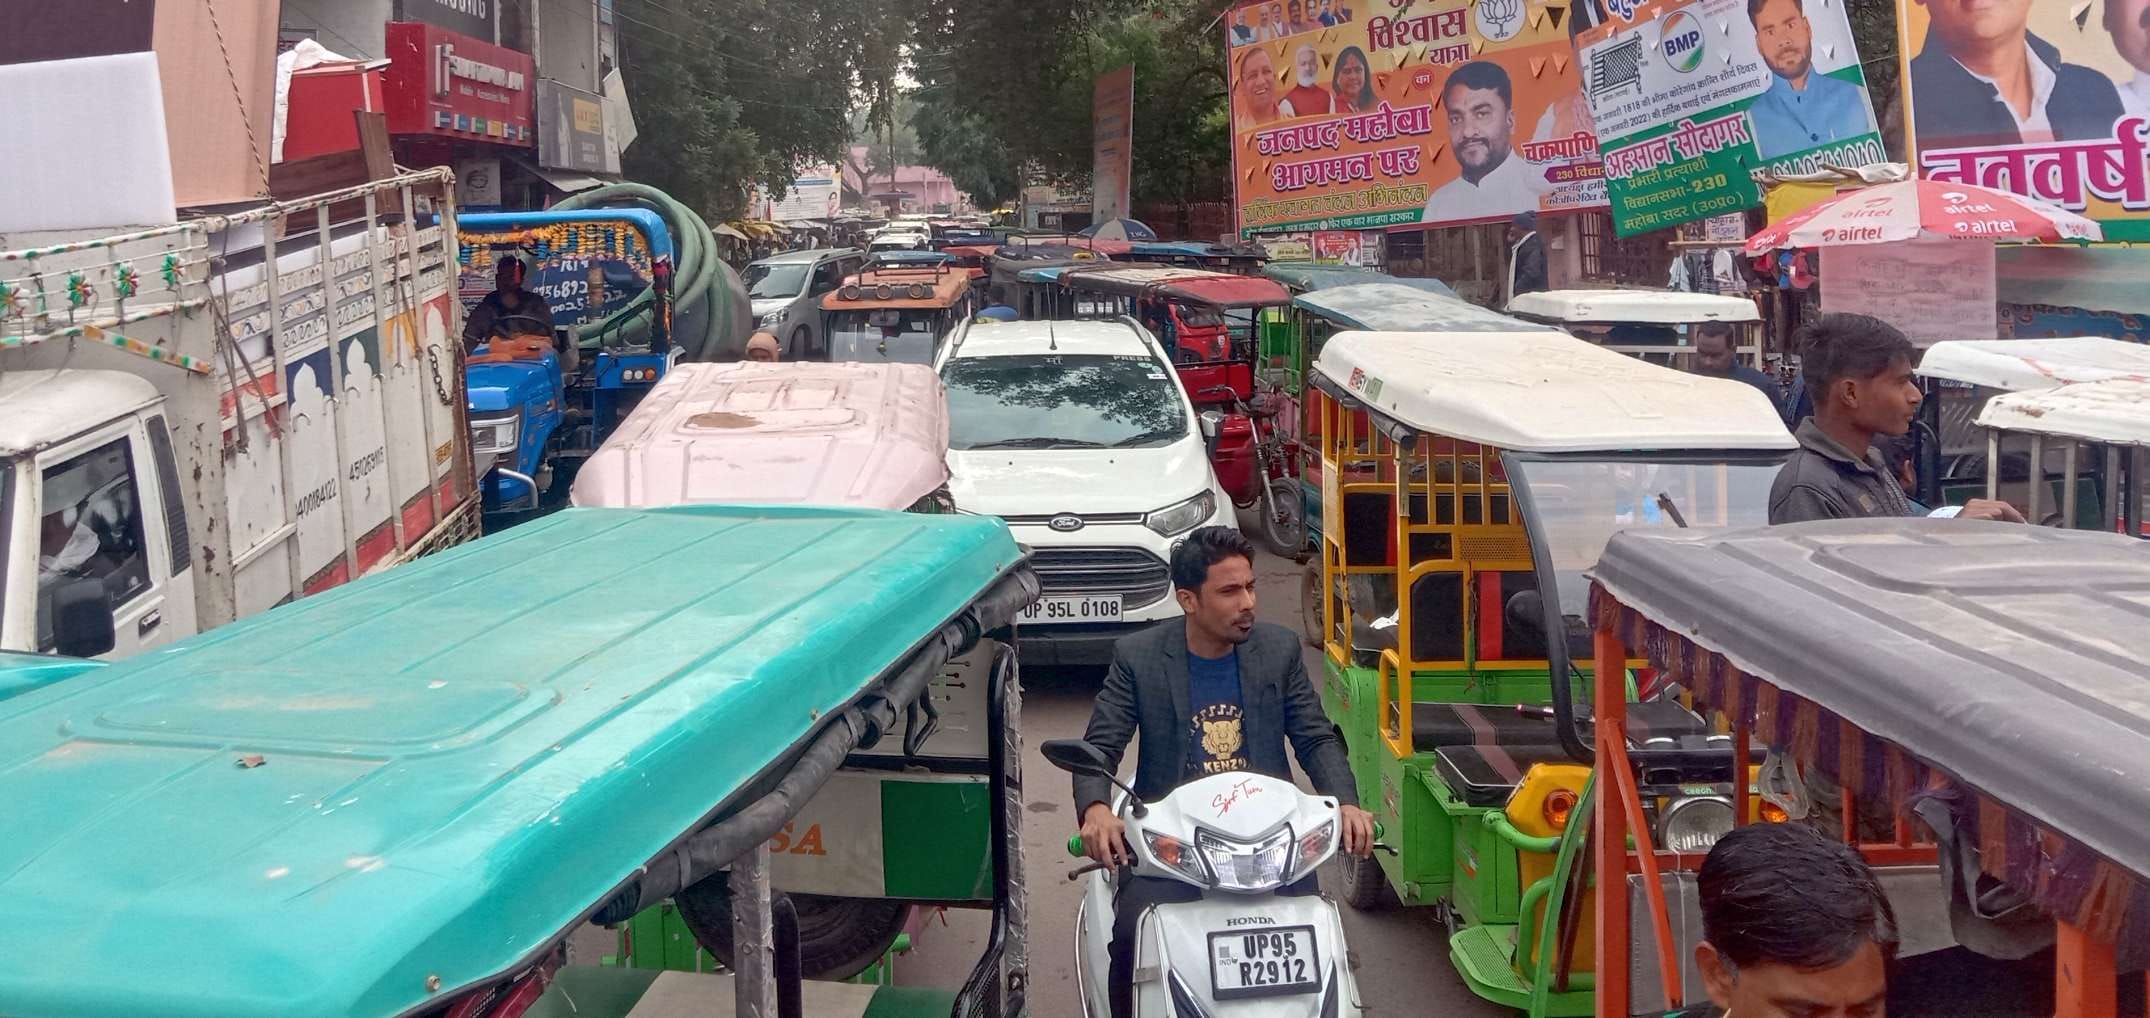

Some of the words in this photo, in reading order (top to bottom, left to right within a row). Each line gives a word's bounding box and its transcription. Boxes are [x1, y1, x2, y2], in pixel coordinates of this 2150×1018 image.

[1367, 8, 1467, 53] विश्वास
[1664, 30, 1700, 57] BMP
[1430, 43, 1470, 65] यात्रा
[1257, 120, 1341, 155] जनपद
[1344, 102, 1431, 143] महोबा
[1273, 152, 1373, 191] आगमन
[1377, 146, 1419, 176] पर
[1556, 171, 1573, 180] 230
[1662, 204, 1690, 220] सदर
[1841, 204, 1893, 220] airtel
[1944, 200, 1997, 214] airtel
[1840, 225, 1882, 242] airtel
[1971, 219, 2018, 234] airtel
[1023, 601, 1042, 619] UP
[1048, 601, 1075, 618] 95L
[1081, 601, 1119, 617] 0108
[1226, 917, 1276, 926] HONDA
[1243, 933, 1297, 959] UP95
[1239, 959, 1307, 986] R2912
